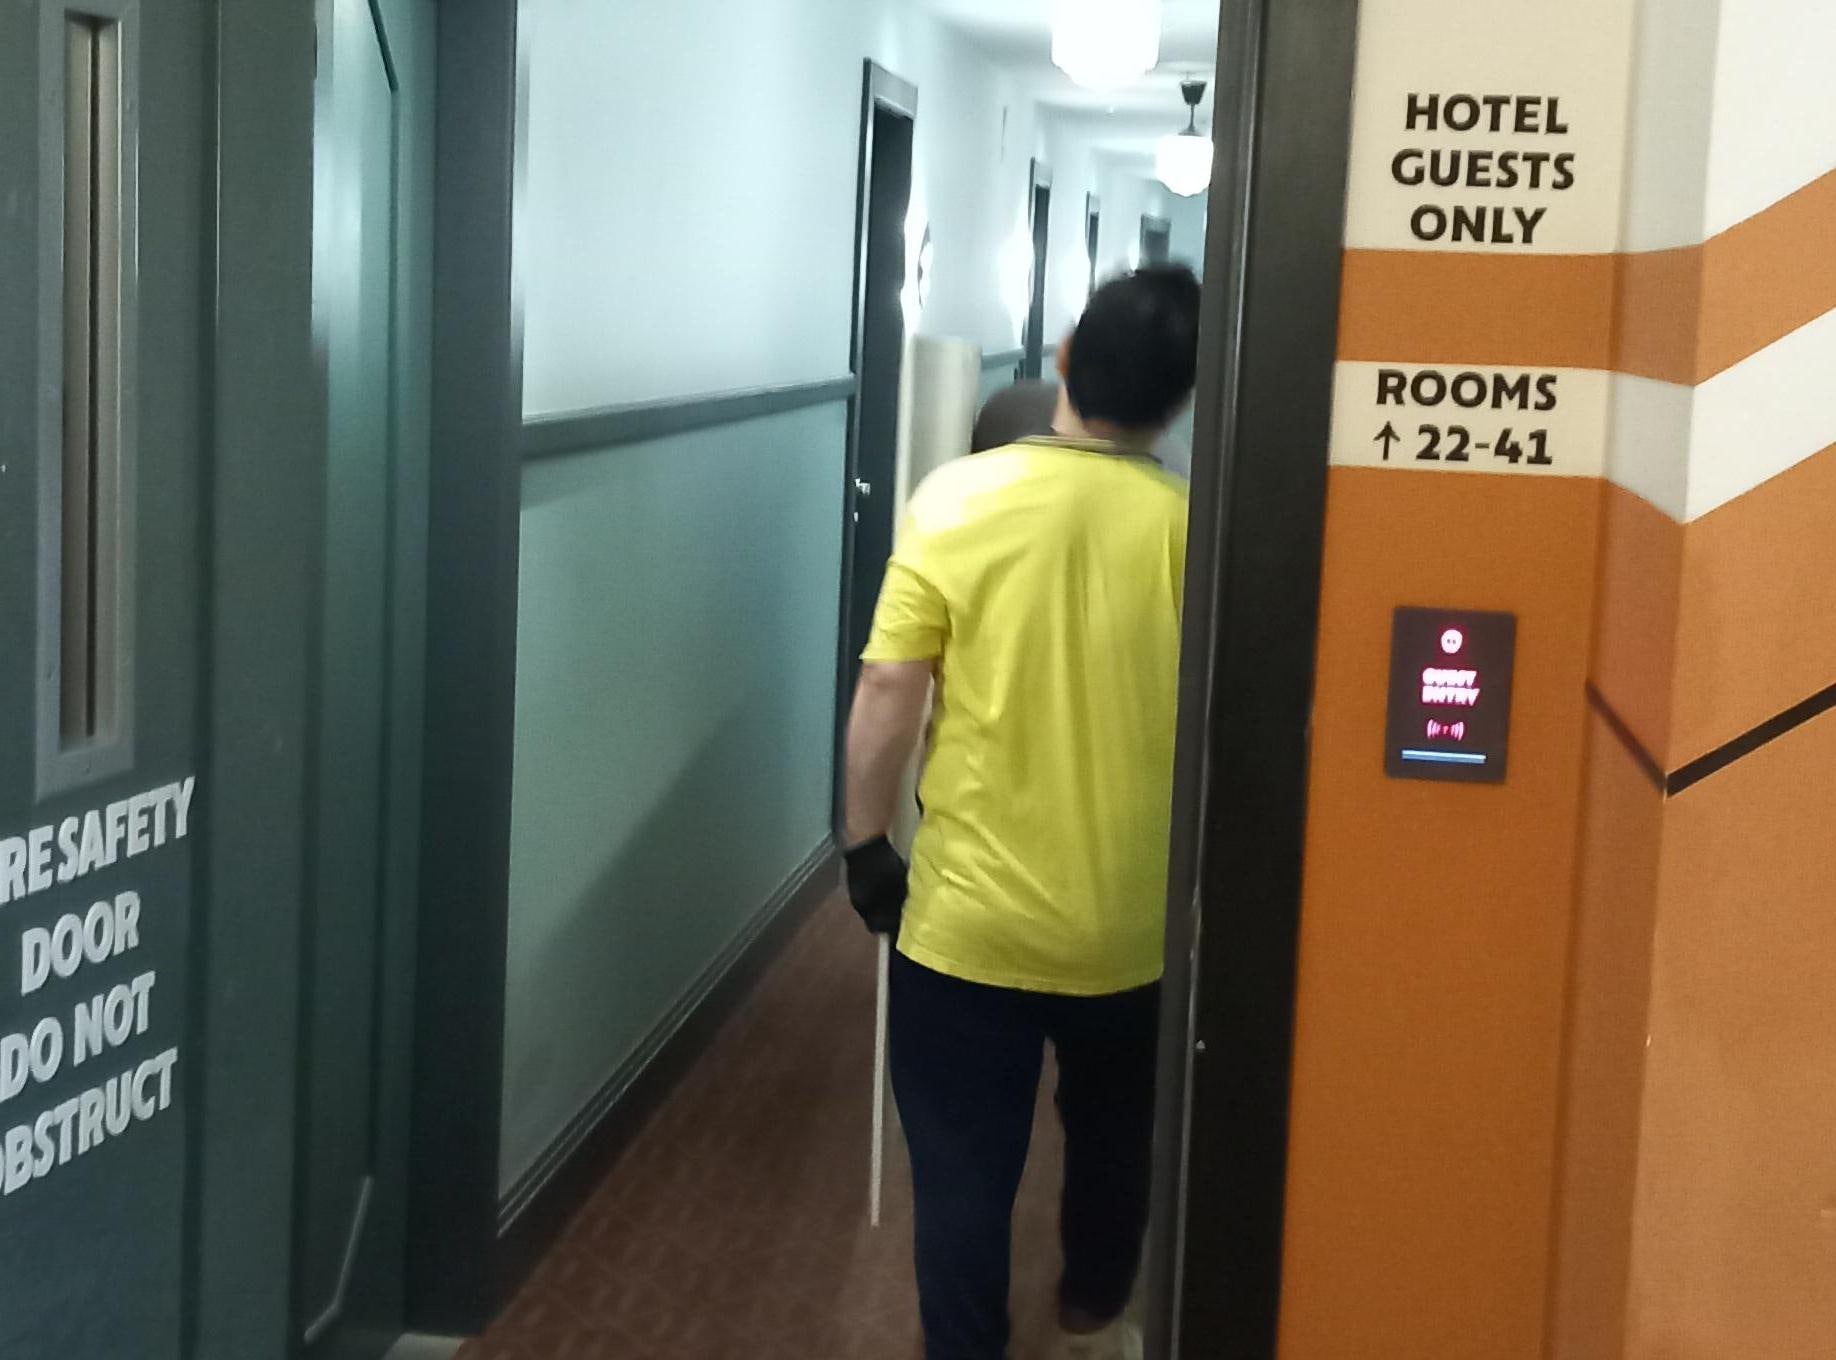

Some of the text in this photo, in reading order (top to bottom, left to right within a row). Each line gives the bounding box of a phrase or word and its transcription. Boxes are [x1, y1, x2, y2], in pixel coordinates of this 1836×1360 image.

[1405, 93, 1568, 134] HOTEL
[1391, 149, 1575, 190] GUESTS
[1411, 204, 1547, 244] ONLY
[1376, 369, 1557, 411] ROOMS
[1416, 424, 1553, 465] 22-41
[57, 776, 195, 882] SAFETY
[21, 891, 140, 997] DOOR
[0, 971, 155, 1102] DO NOT
[0, 1047, 177, 1195] BSTRUCT
